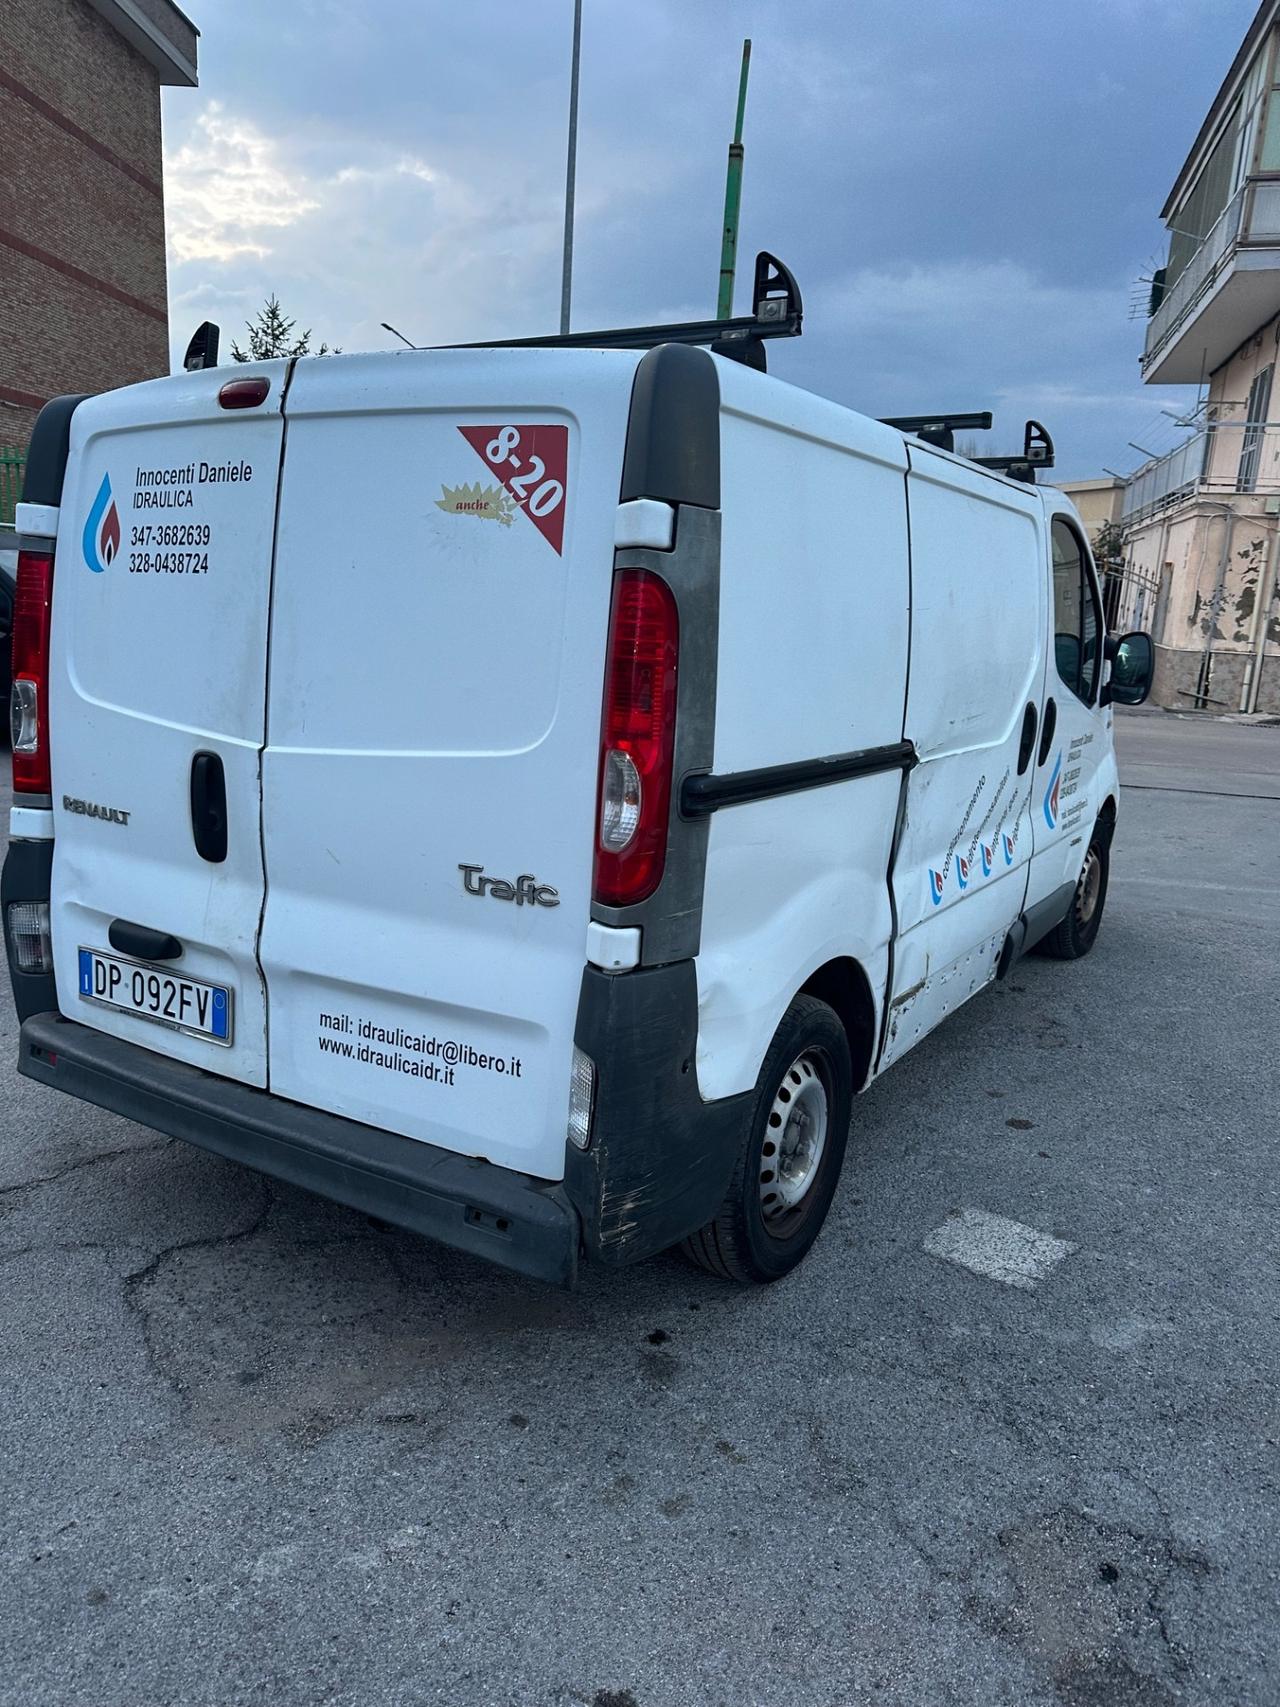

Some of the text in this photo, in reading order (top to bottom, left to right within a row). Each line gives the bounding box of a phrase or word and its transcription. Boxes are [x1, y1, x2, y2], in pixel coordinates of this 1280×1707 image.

[136, 460, 252, 487] Innocenti Daniele
[485, 425, 564, 517] 8-20
[133, 490, 193, 509] IDRAULICA
[455, 499, 490, 511] anche
[131, 525, 210, 546] 347-3682639
[129, 553, 209, 574] 328-0438724
[63, 795, 130, 825] RENAULT
[458, 863, 561, 907] Trafic
[95, 959, 121, 999] DP
[132, 971, 209, 1026] 092FV
[319, 1012, 522, 1078] mail: idraulicaidr@libero.it
[318, 1035, 454, 1086] www.idraulicaidr.it
